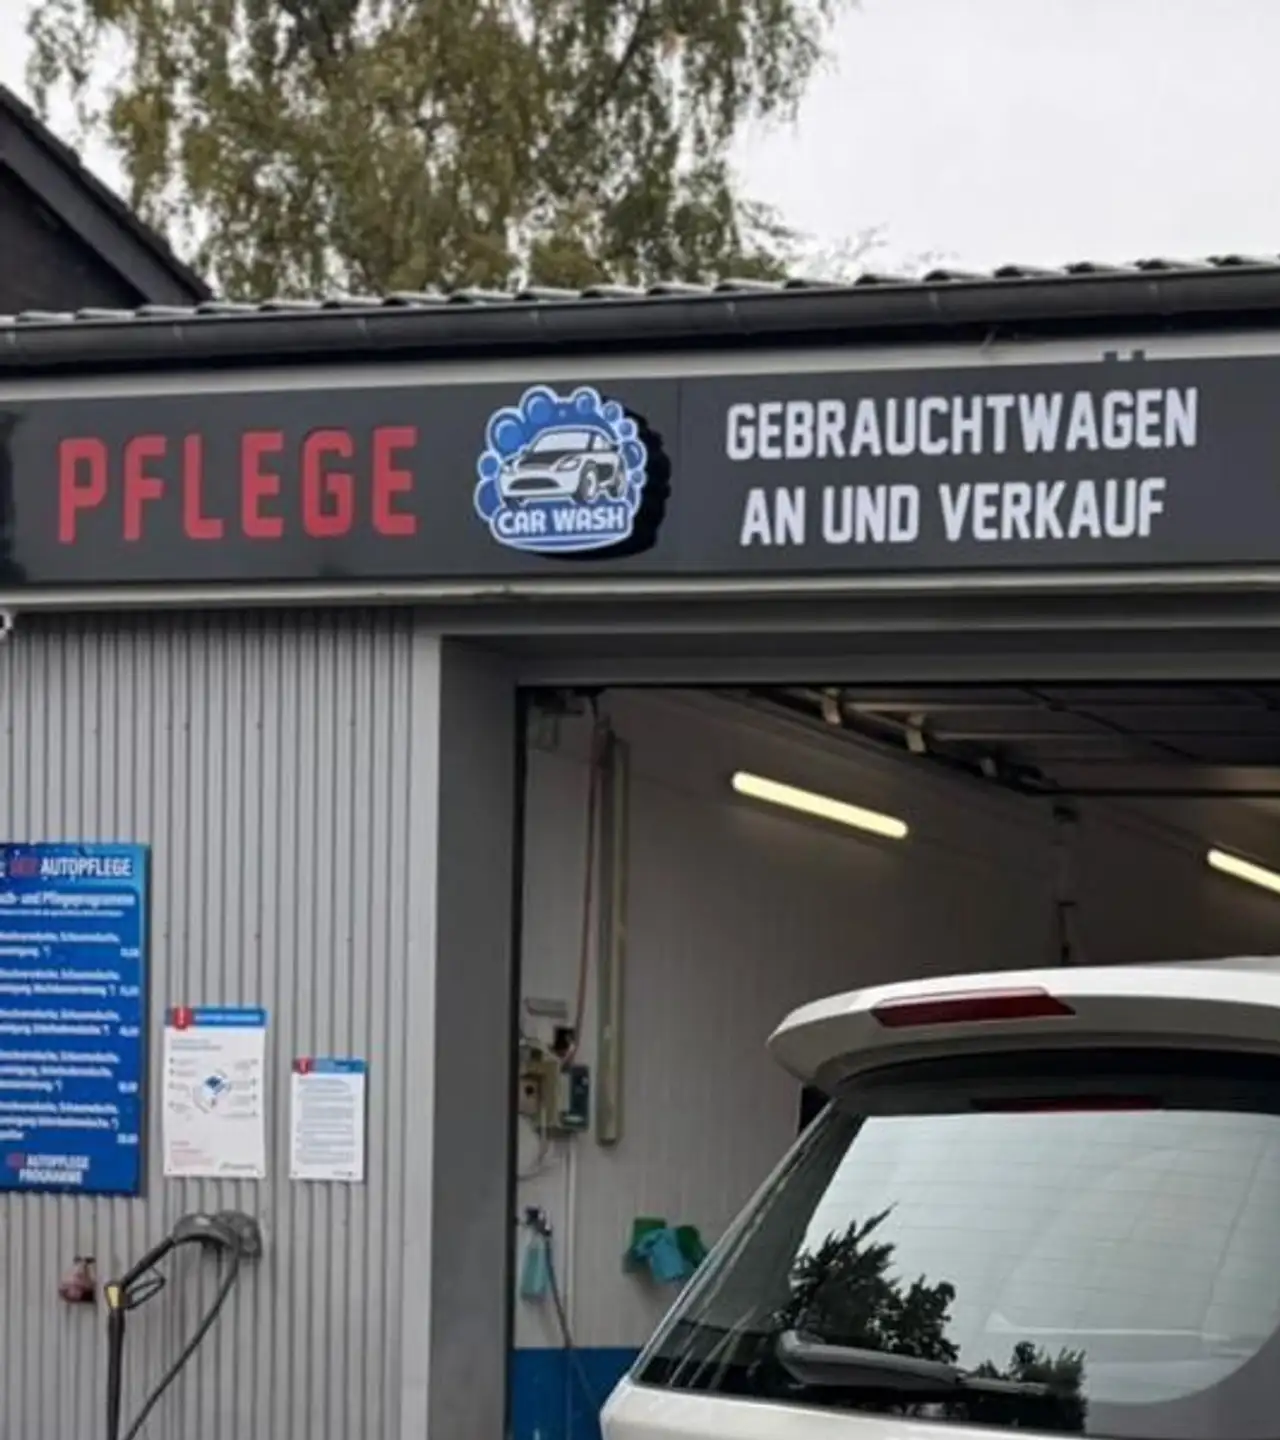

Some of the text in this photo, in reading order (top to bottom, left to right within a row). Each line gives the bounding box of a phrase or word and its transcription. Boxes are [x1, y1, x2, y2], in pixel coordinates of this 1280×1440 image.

[726, 385, 1198, 461] GEBRAUCHTWAGEN
[57, 424, 418, 545] PFLEGE
[497, 505, 626, 535] CAR WASH
[740, 476, 1167, 547] AN UND VERKAUF
